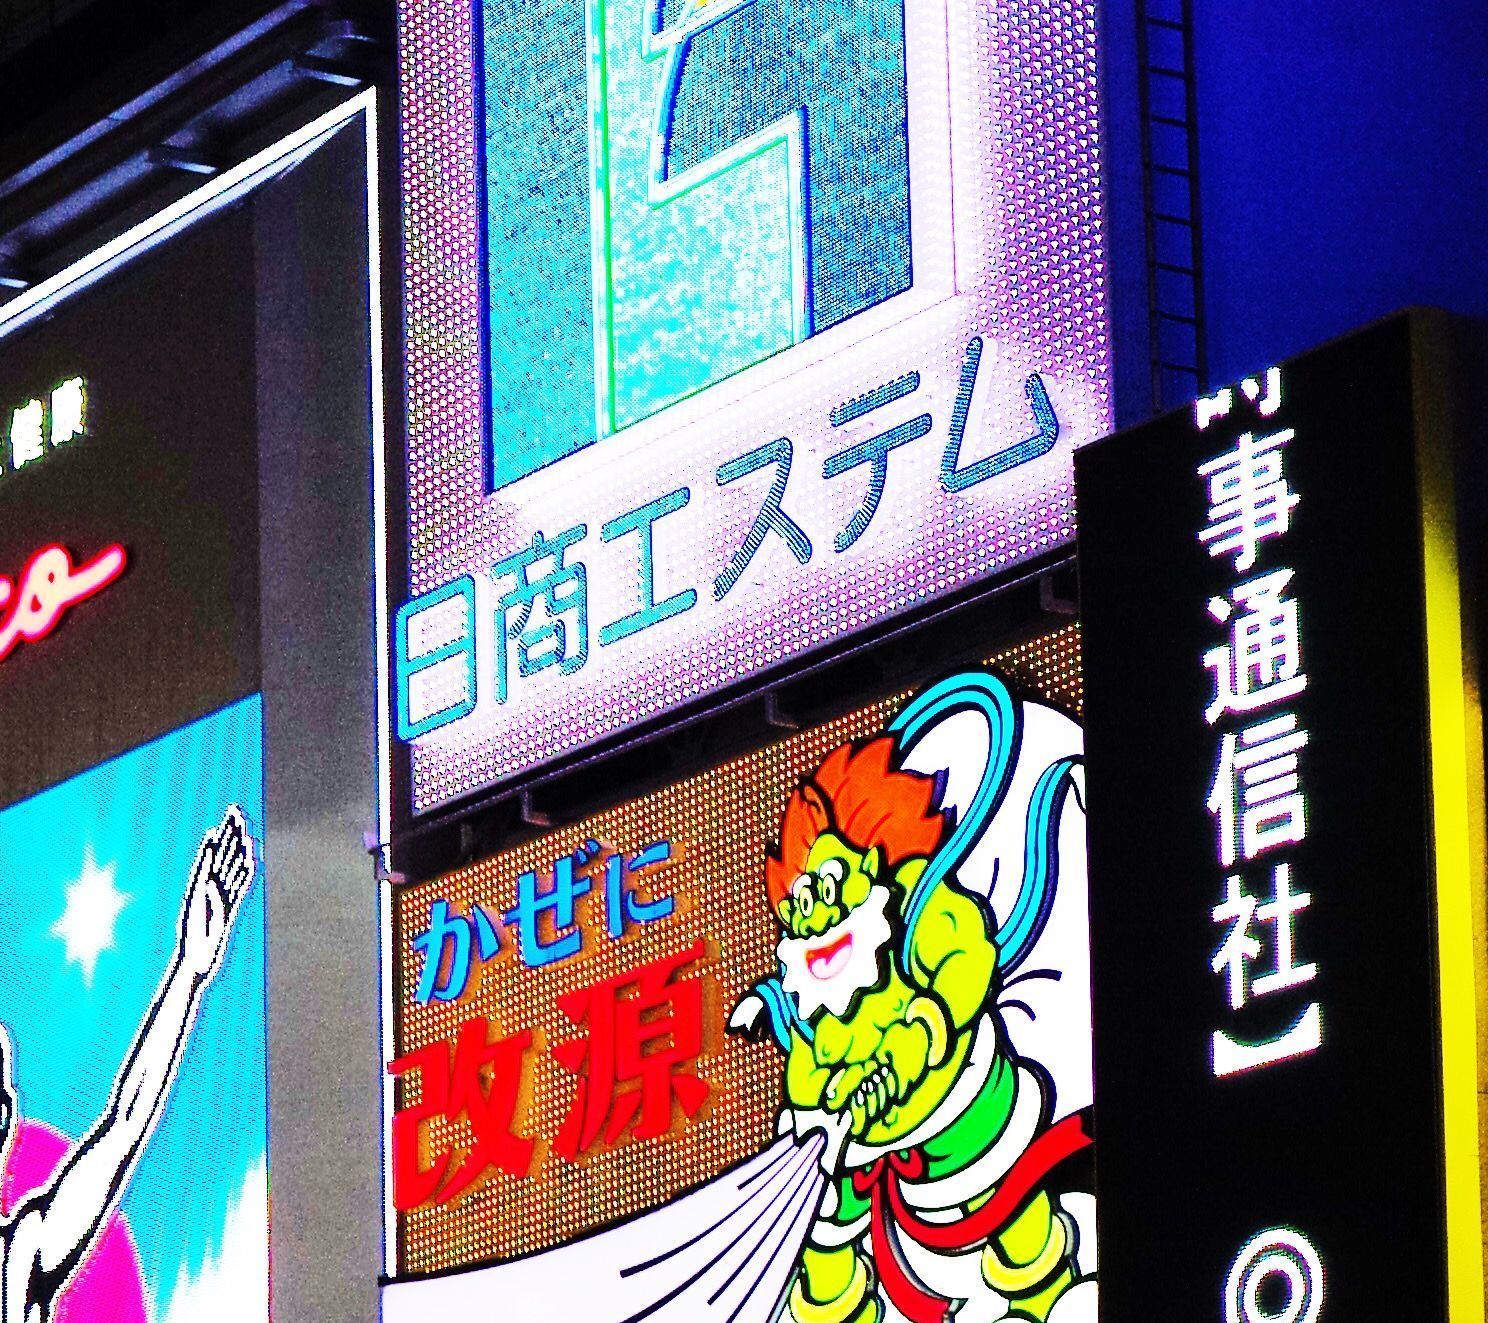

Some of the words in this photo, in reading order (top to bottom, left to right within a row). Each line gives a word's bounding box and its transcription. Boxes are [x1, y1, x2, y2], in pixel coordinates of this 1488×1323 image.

[393, 335, 1062, 743] 日商エステム
[414, 838, 677, 1006] かぜに
[389, 940, 713, 1212] 改源
